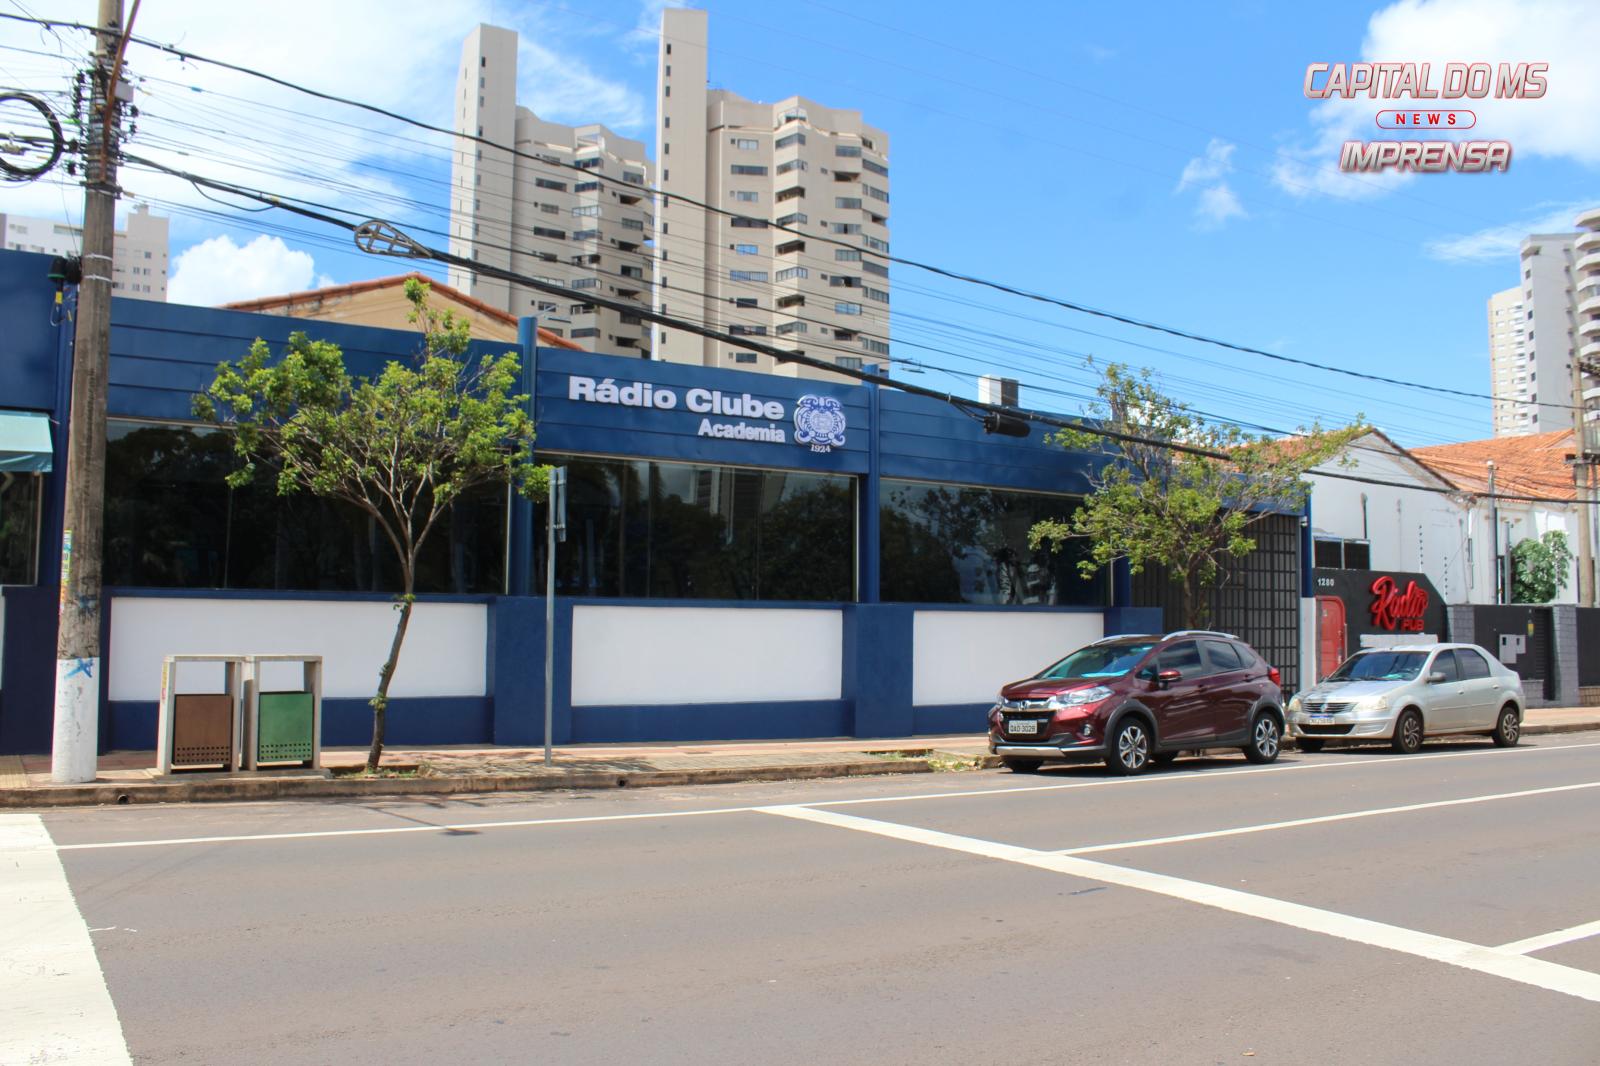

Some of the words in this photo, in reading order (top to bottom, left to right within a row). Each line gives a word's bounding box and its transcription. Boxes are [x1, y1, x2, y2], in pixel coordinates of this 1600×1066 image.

[568, 375, 676, 410] Rádio
[685, 387, 785, 420] Clube
[697, 418, 786, 443] Academia
[810, 444, 831, 453] 1924
[1401, 619, 1424, 631] PUB
